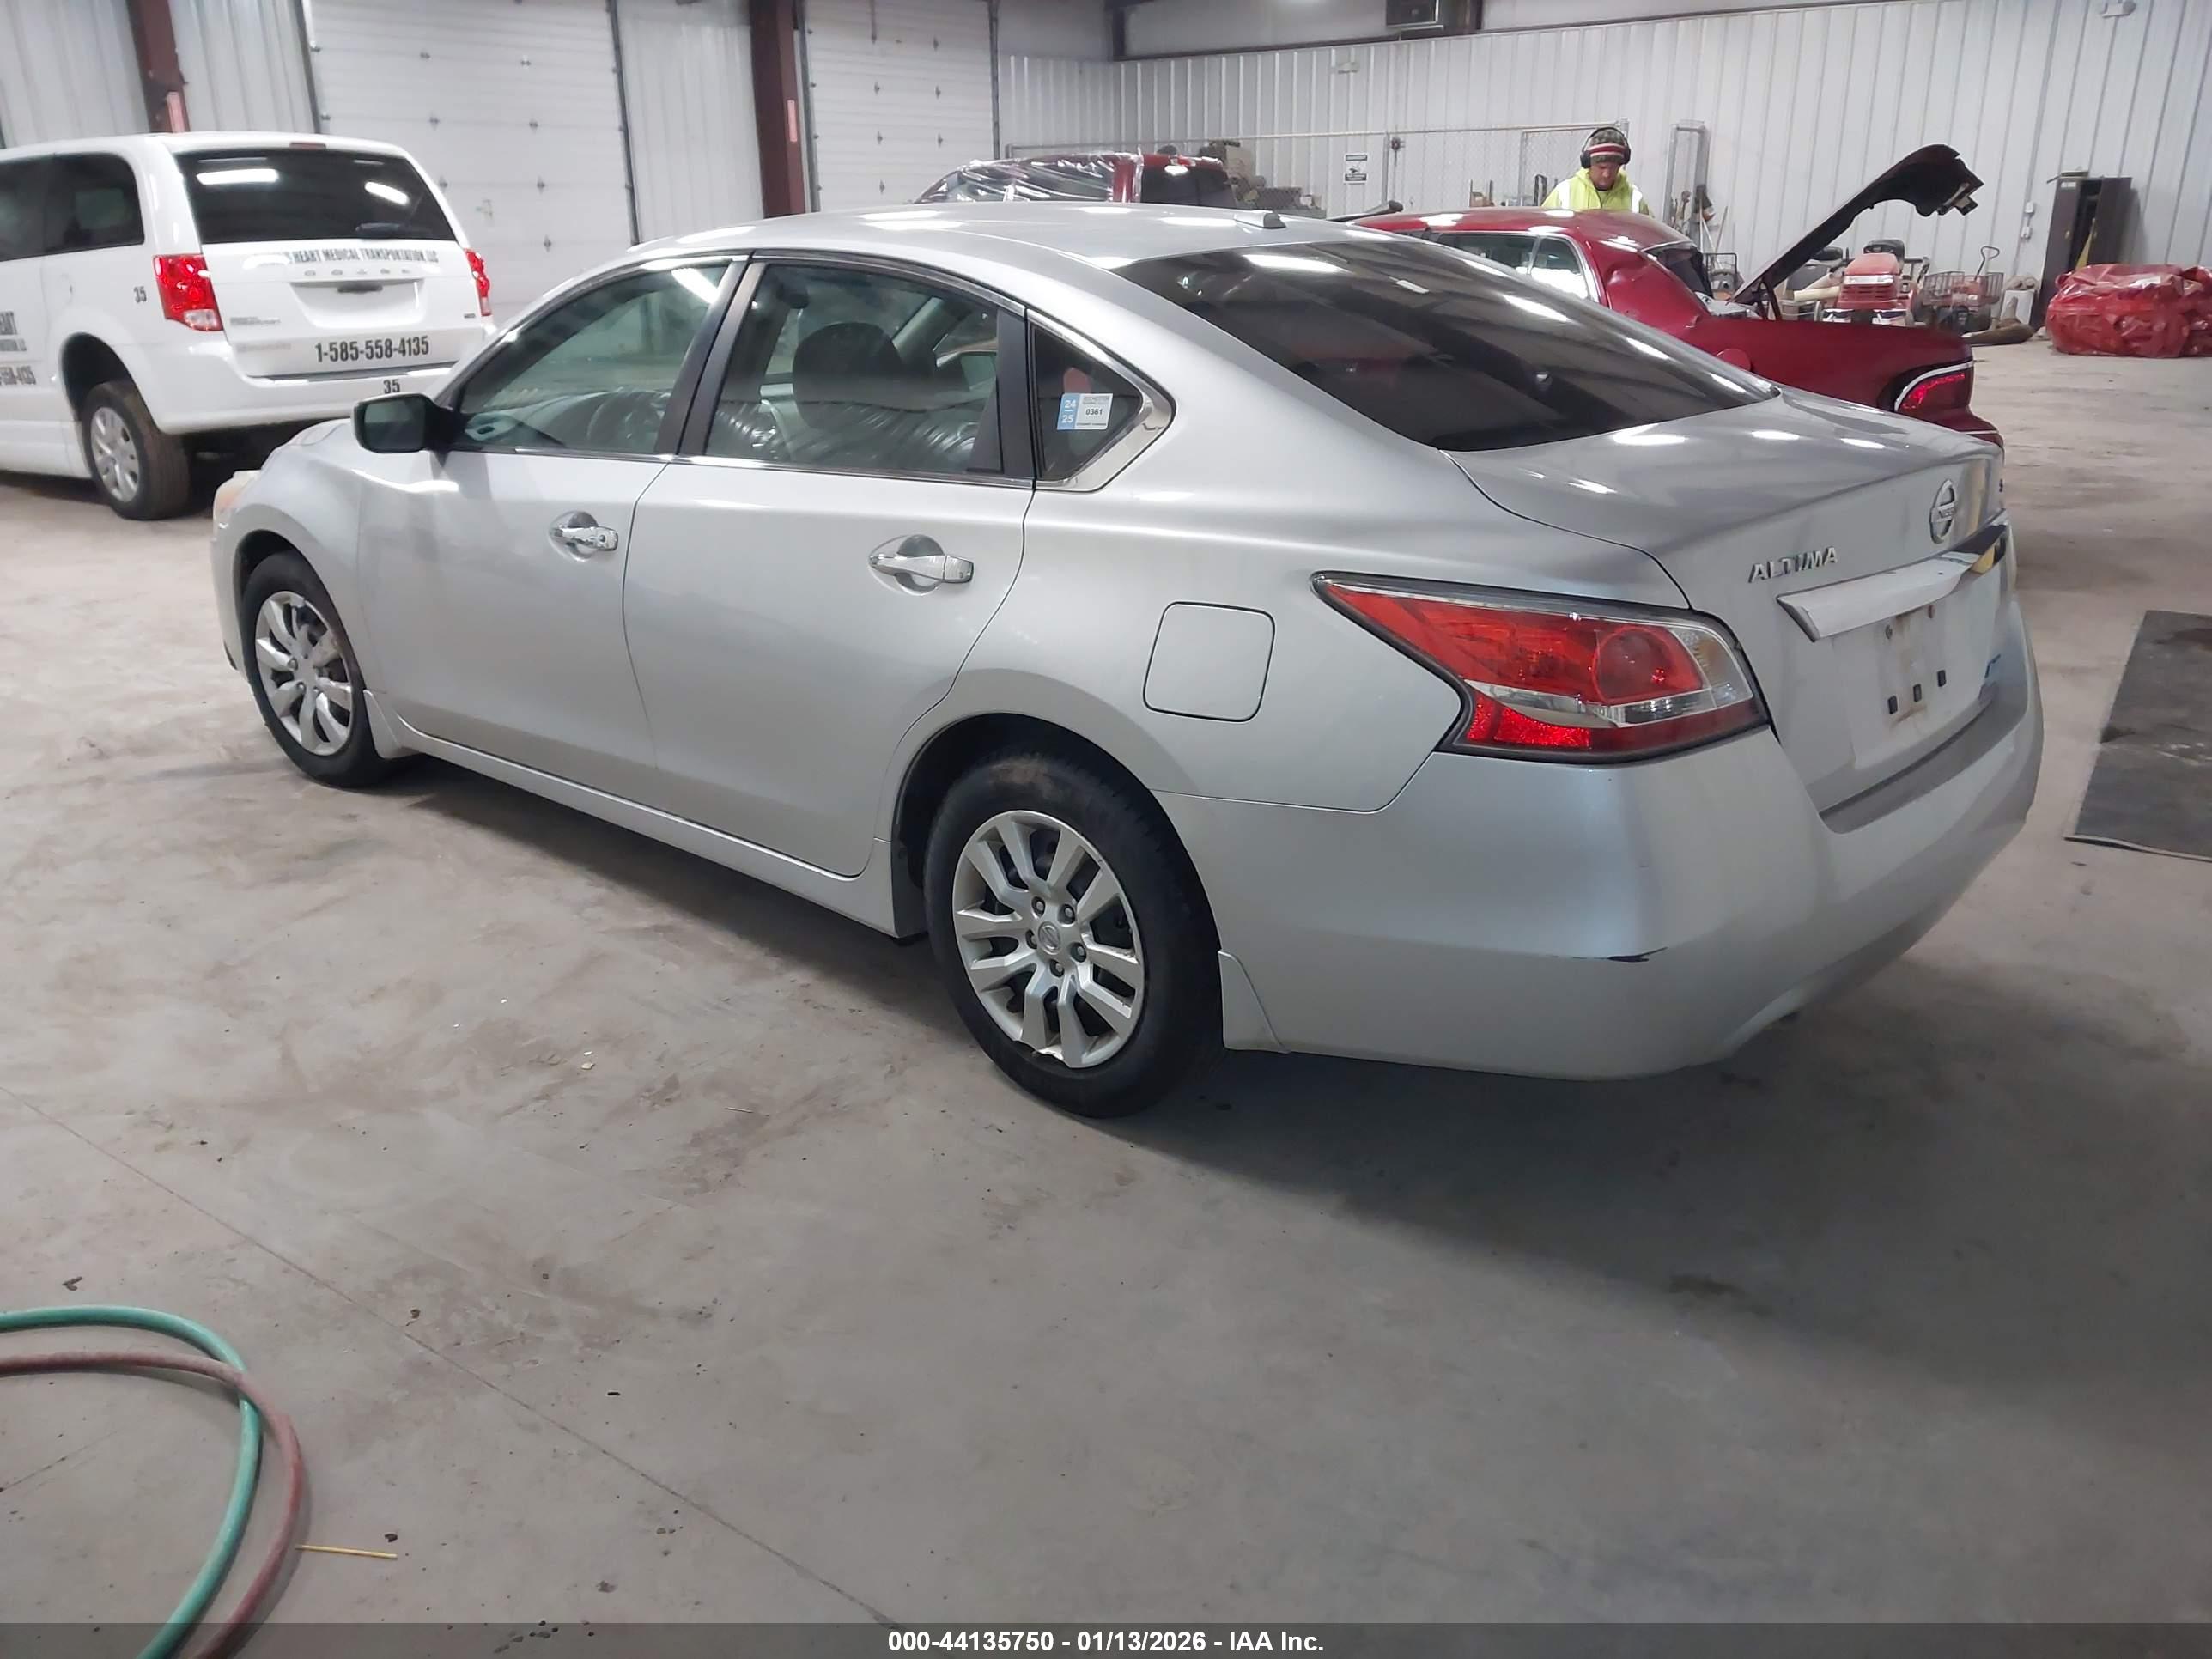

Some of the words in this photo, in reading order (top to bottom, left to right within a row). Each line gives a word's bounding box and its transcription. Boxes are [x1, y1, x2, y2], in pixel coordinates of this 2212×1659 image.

[134, 286, 147, 303] 35
[315, 336, 429, 362] 1-585-558-4135
[383, 379, 401, 394] 35
[1064, 399, 1077, 409] 24
[1061, 414, 1074, 423] 25
[1748, 546, 1838, 583] ALTIMA
